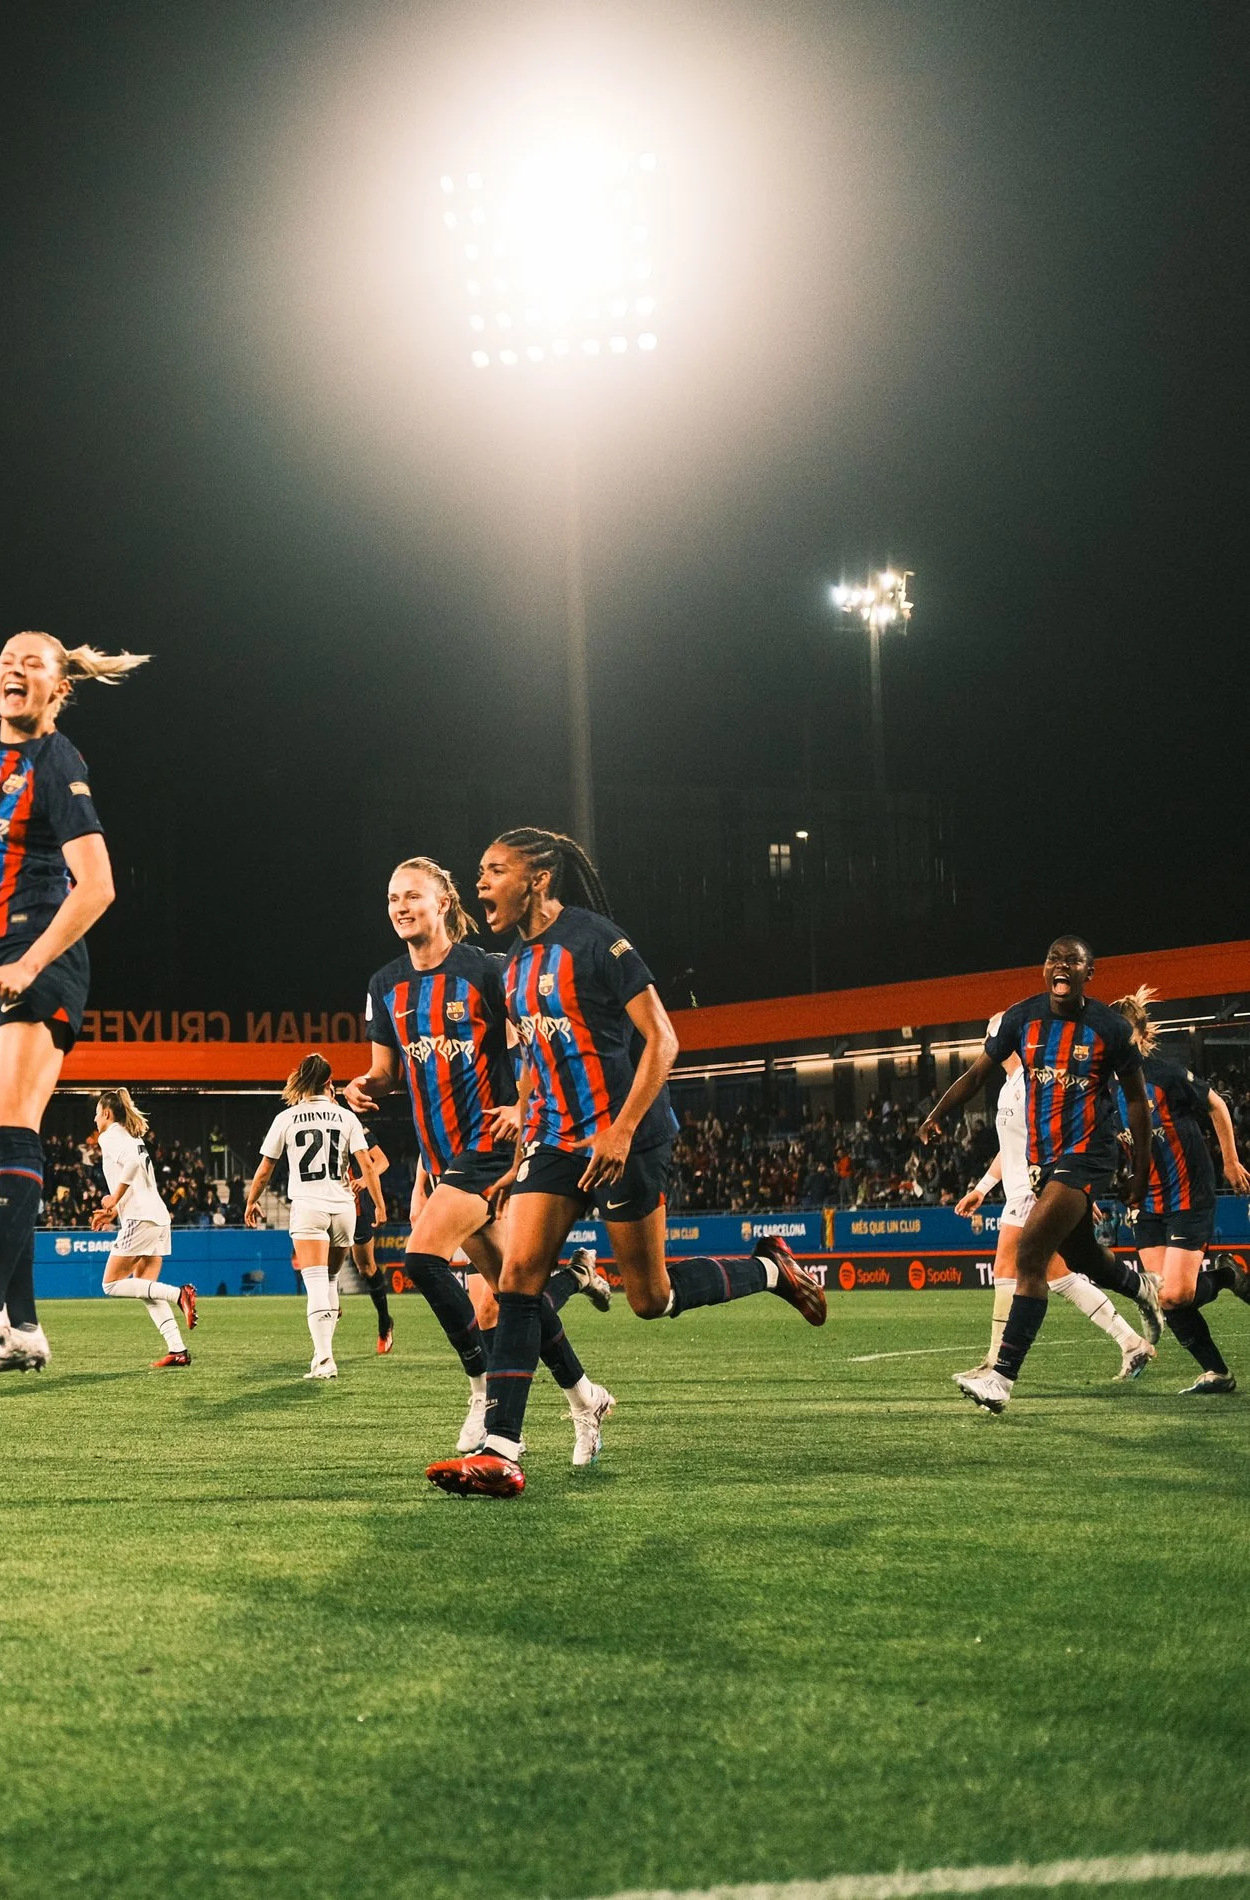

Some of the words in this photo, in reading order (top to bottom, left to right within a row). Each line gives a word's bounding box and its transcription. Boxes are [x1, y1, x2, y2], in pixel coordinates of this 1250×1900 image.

[291, 1111, 343, 1124] ZORNOZA
[294, 1128, 342, 1182] 21
[851, 1218, 868, 1235] MÉS
[869, 1220, 885, 1237] QUE
[886, 1220, 899, 1234] UN
[900, 1219, 921, 1233] CLUB
[857, 1268, 890, 1286] Spotify
[927, 1267, 962, 1285] Spotify
